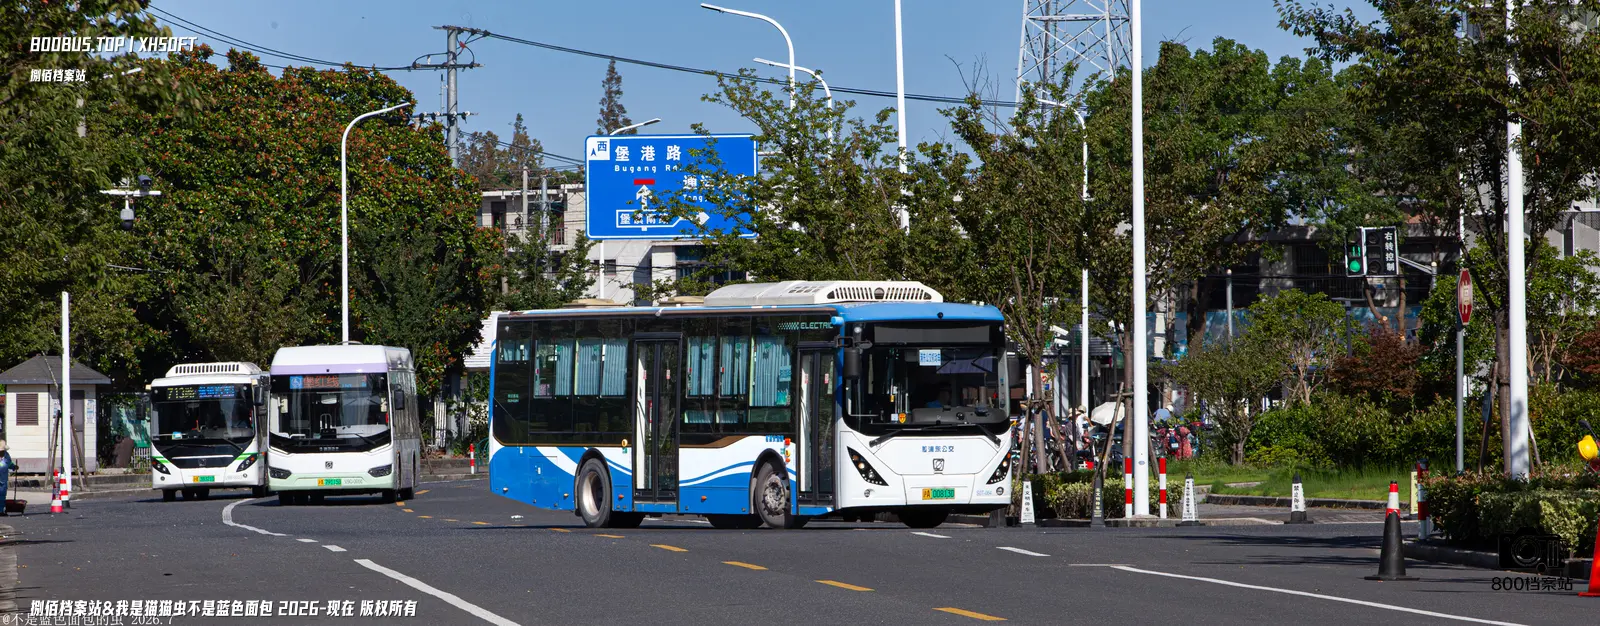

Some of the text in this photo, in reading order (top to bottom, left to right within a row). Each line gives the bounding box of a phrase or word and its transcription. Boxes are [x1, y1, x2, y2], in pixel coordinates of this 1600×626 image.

[597, 140, 608, 152] 西
[615, 144, 682, 162] 堡港路
[614, 164, 657, 173] Bugang
[1384, 231, 1395, 271] 右转控制
